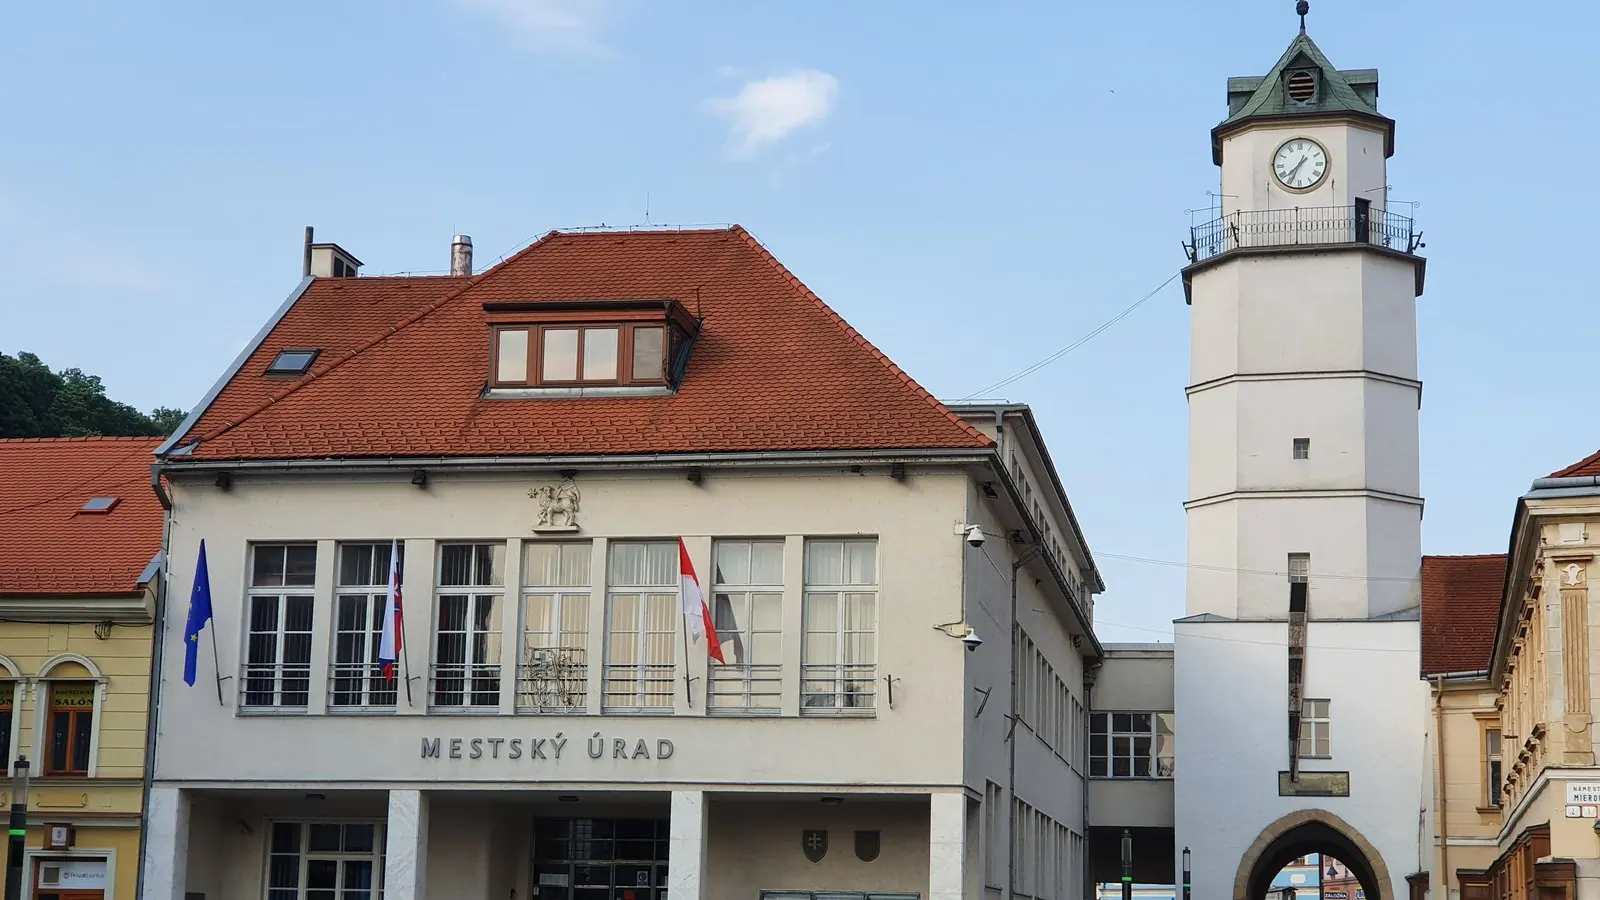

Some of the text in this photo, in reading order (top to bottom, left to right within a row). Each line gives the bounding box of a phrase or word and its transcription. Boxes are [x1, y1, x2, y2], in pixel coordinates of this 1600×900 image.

[55, 696, 94, 705] SALÓN
[420, 732, 674, 760] MESTSKÝ ÚRAD
